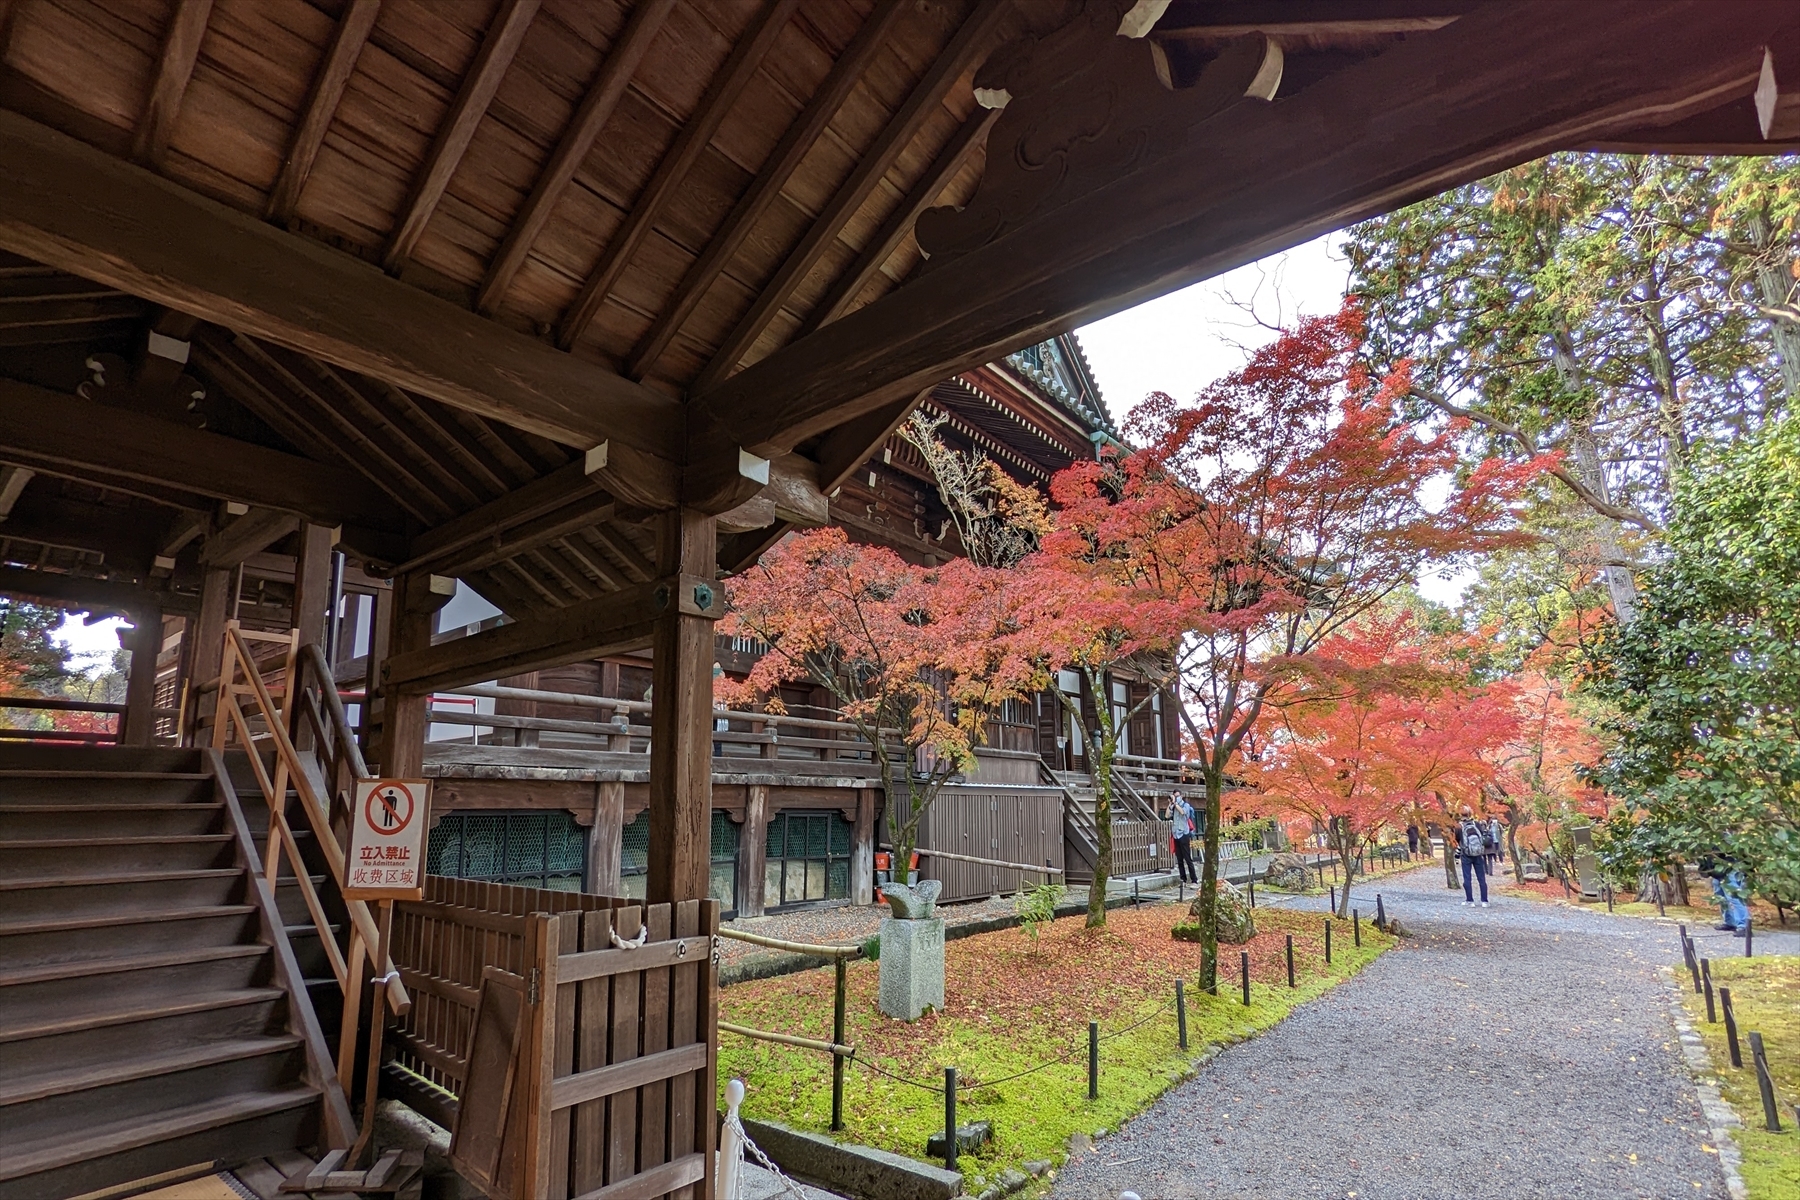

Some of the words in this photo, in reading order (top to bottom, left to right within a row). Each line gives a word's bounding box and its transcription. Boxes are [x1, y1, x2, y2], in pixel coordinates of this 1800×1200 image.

[360, 846, 410, 860] 立入禁止
[353, 868, 414, 884] 收费区域
